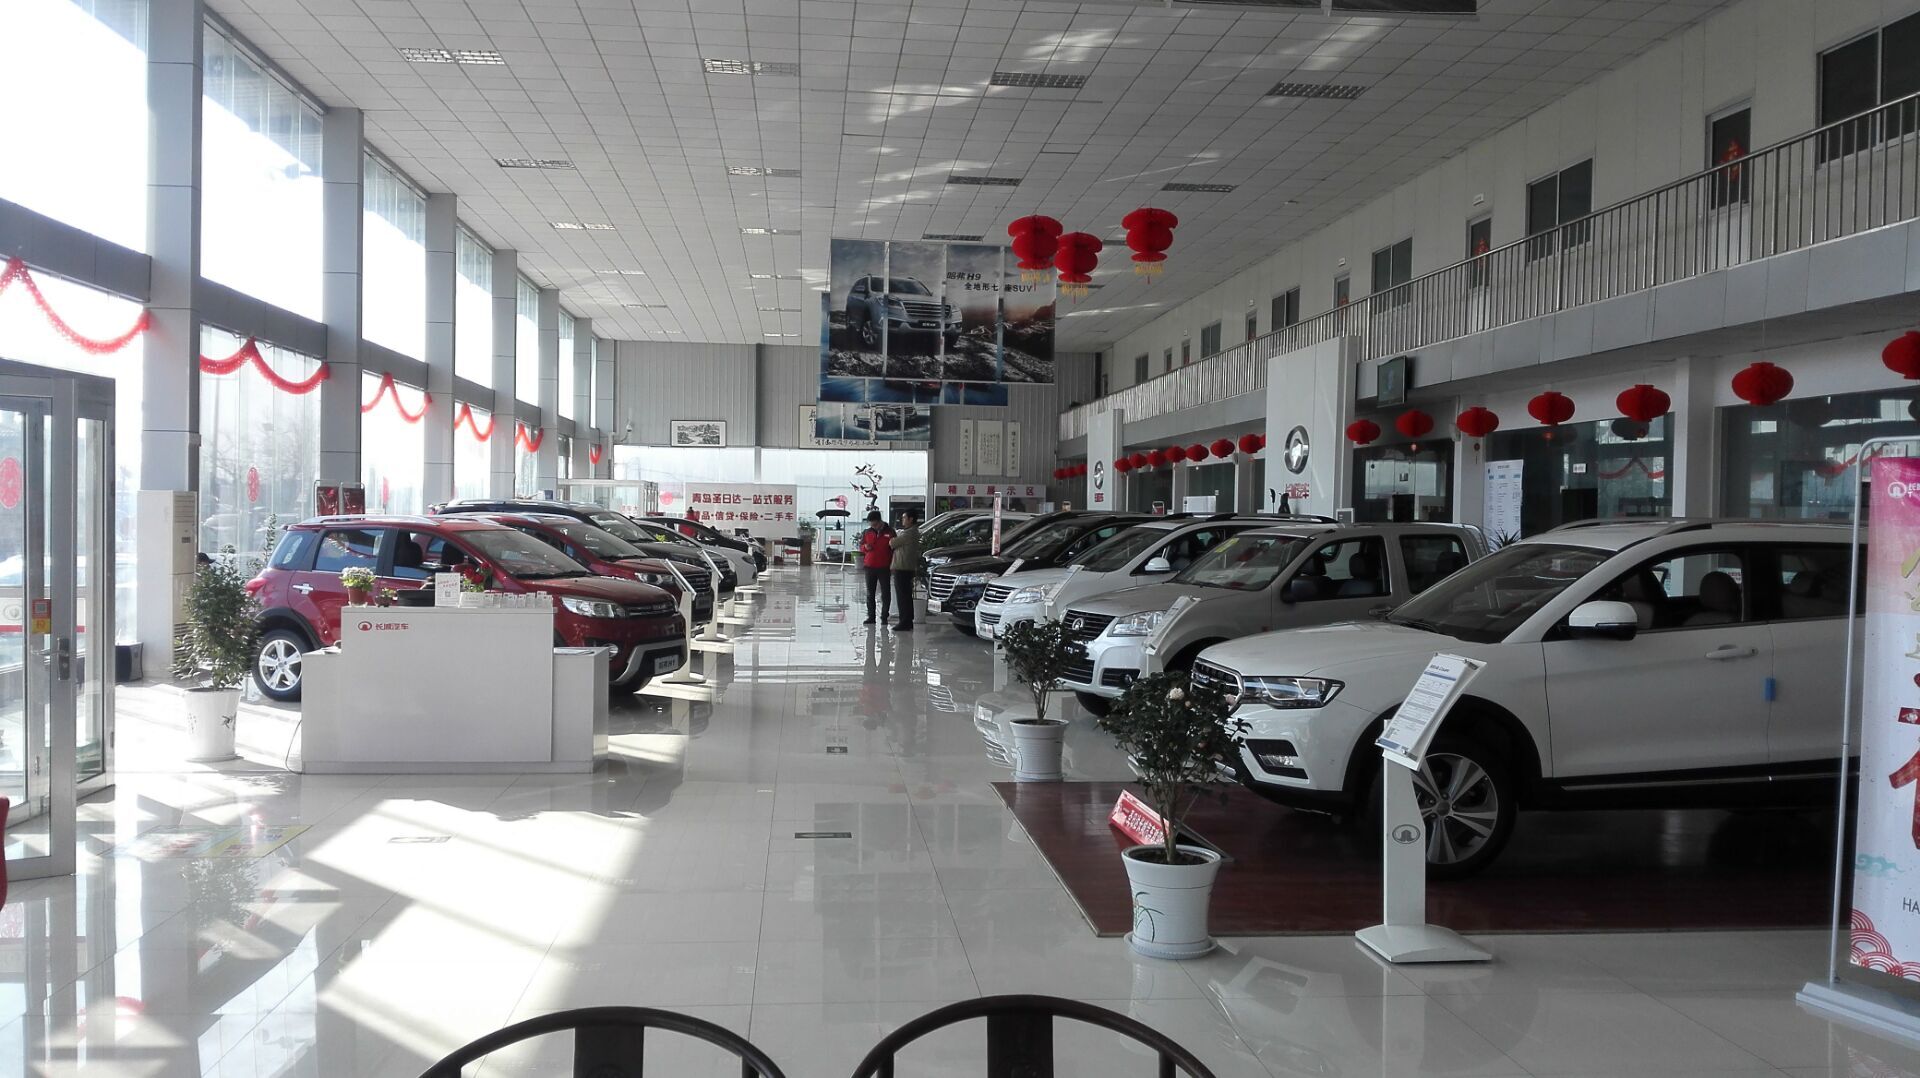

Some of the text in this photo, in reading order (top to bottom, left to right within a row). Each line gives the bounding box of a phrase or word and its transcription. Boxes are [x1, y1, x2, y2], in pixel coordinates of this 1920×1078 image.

[948, 485, 1034, 496] 精品展示区
[692, 493, 793, 505] 青岛圣日达一站式服务
